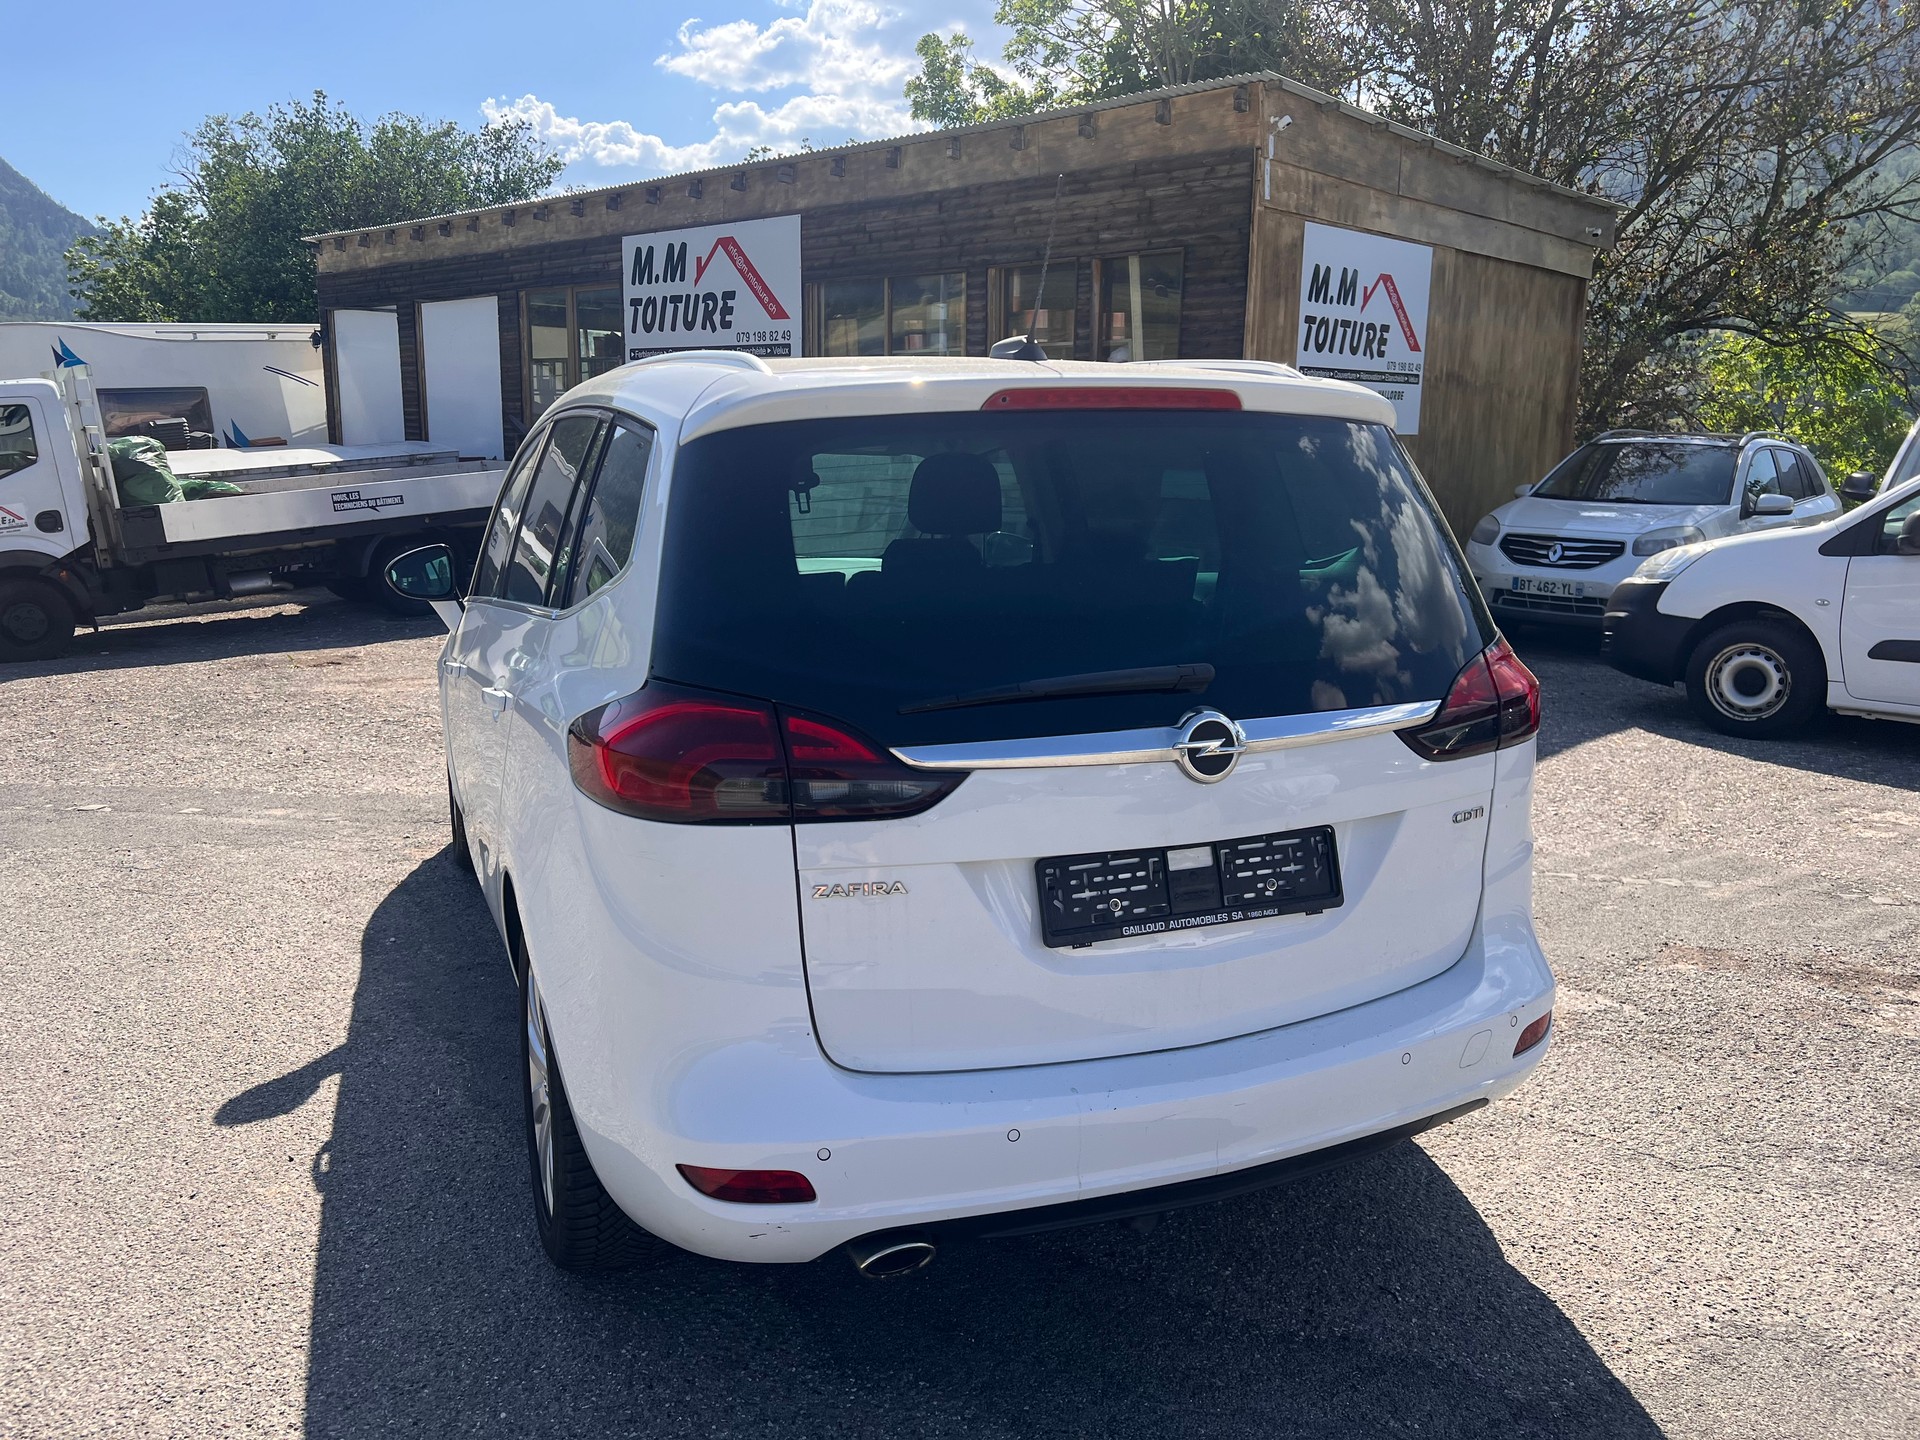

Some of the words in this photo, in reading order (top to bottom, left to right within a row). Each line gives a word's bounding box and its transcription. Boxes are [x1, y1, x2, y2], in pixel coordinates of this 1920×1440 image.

[631, 241, 687, 286] M.M
[727, 242, 777, 315] info@m.mtoiture.ch
[1307, 263, 1358, 306] M.M
[630, 290, 736, 334] TOITURE
[736, 331, 750, 343] 079
[752, 330, 767, 342] 198
[769, 330, 779, 342] 82
[781, 329, 791, 341] 49
[1303, 315, 1390, 360] TOITURE
[772, 346, 790, 355] Velux
[332, 493, 349, 502] NOUS,
[349, 492, 360, 500] LES
[334, 500, 368, 511] TECHNICIENS
[368, 499, 376, 507] DU
[812, 880, 908, 899] ZAFIRA
[1122, 921, 1165, 936] GAILLOUD
[1169, 913, 1229, 930] AUTOMOBILES
[1232, 911, 1244, 921] SA
[1263, 908, 1279, 916] AIGLE
